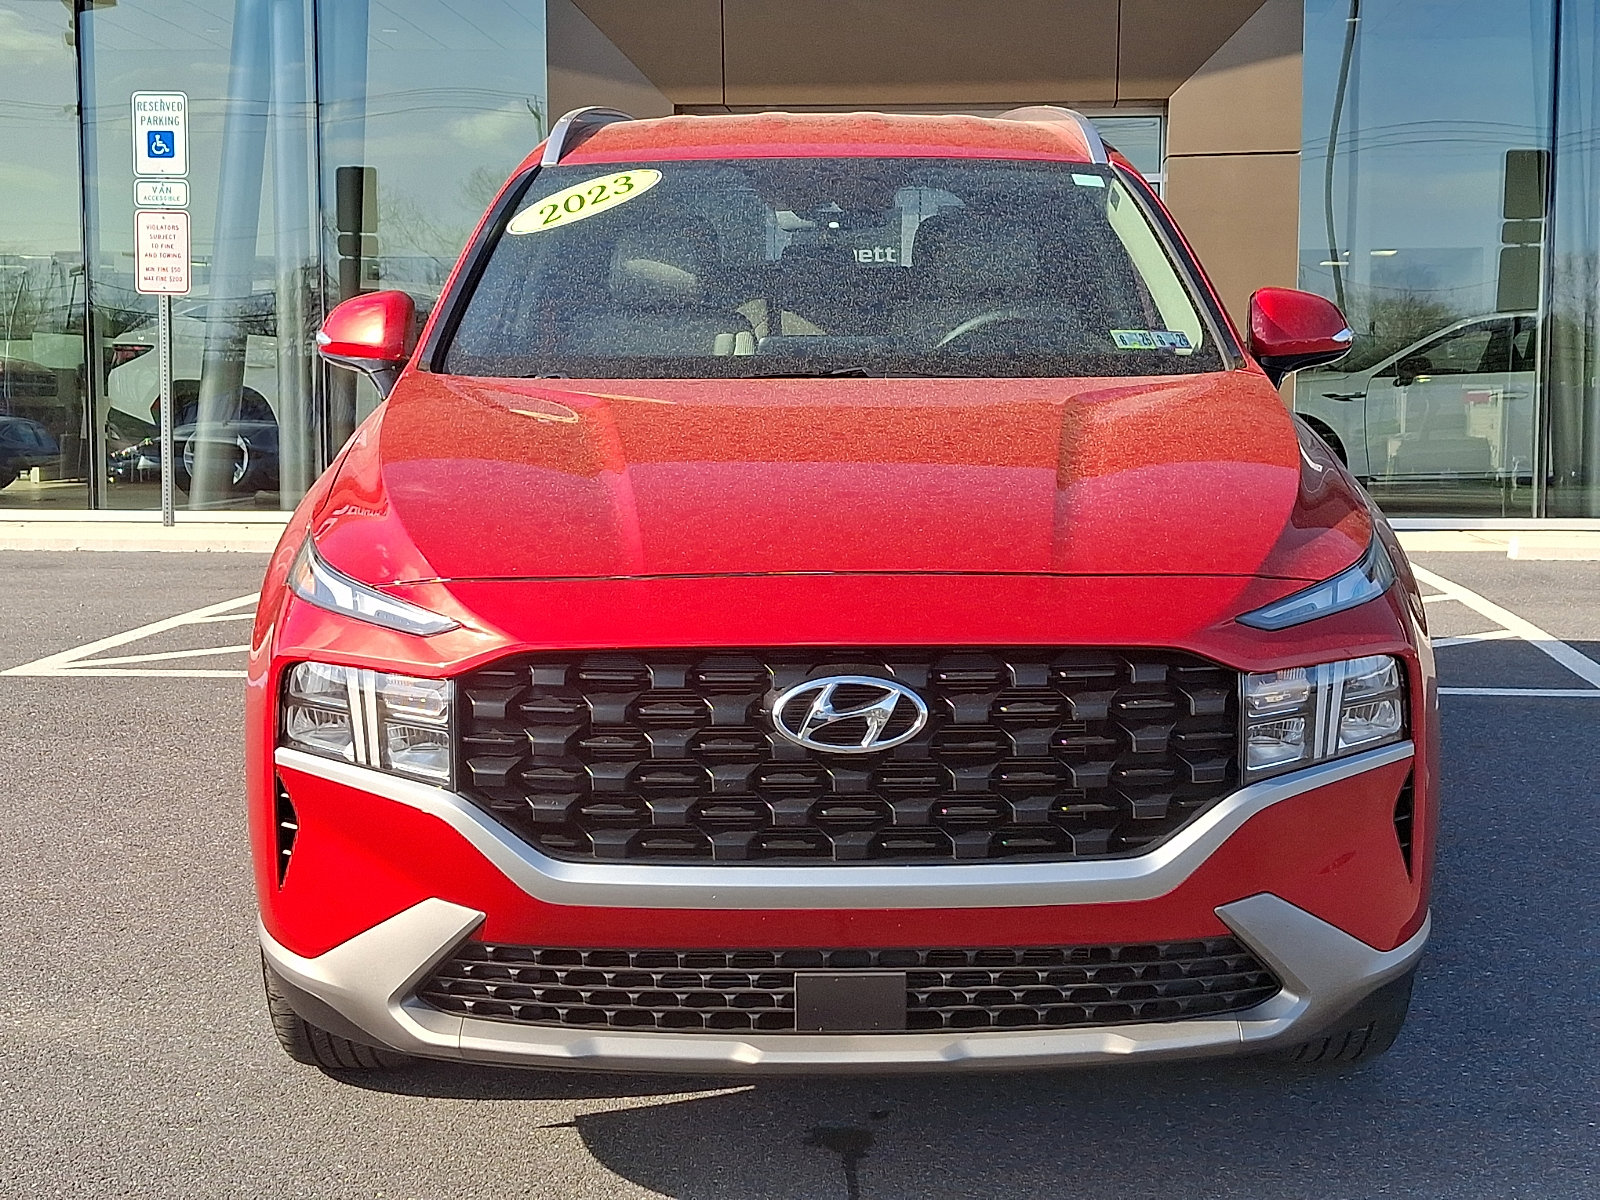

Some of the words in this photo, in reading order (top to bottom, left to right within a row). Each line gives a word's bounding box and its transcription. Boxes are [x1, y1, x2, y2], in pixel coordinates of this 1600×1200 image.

[137, 101, 183, 112] RESERVED
[140, 115, 180, 126] PARKING
[152, 186, 172, 194] VAN
[539, 175, 634, 225] 2023
